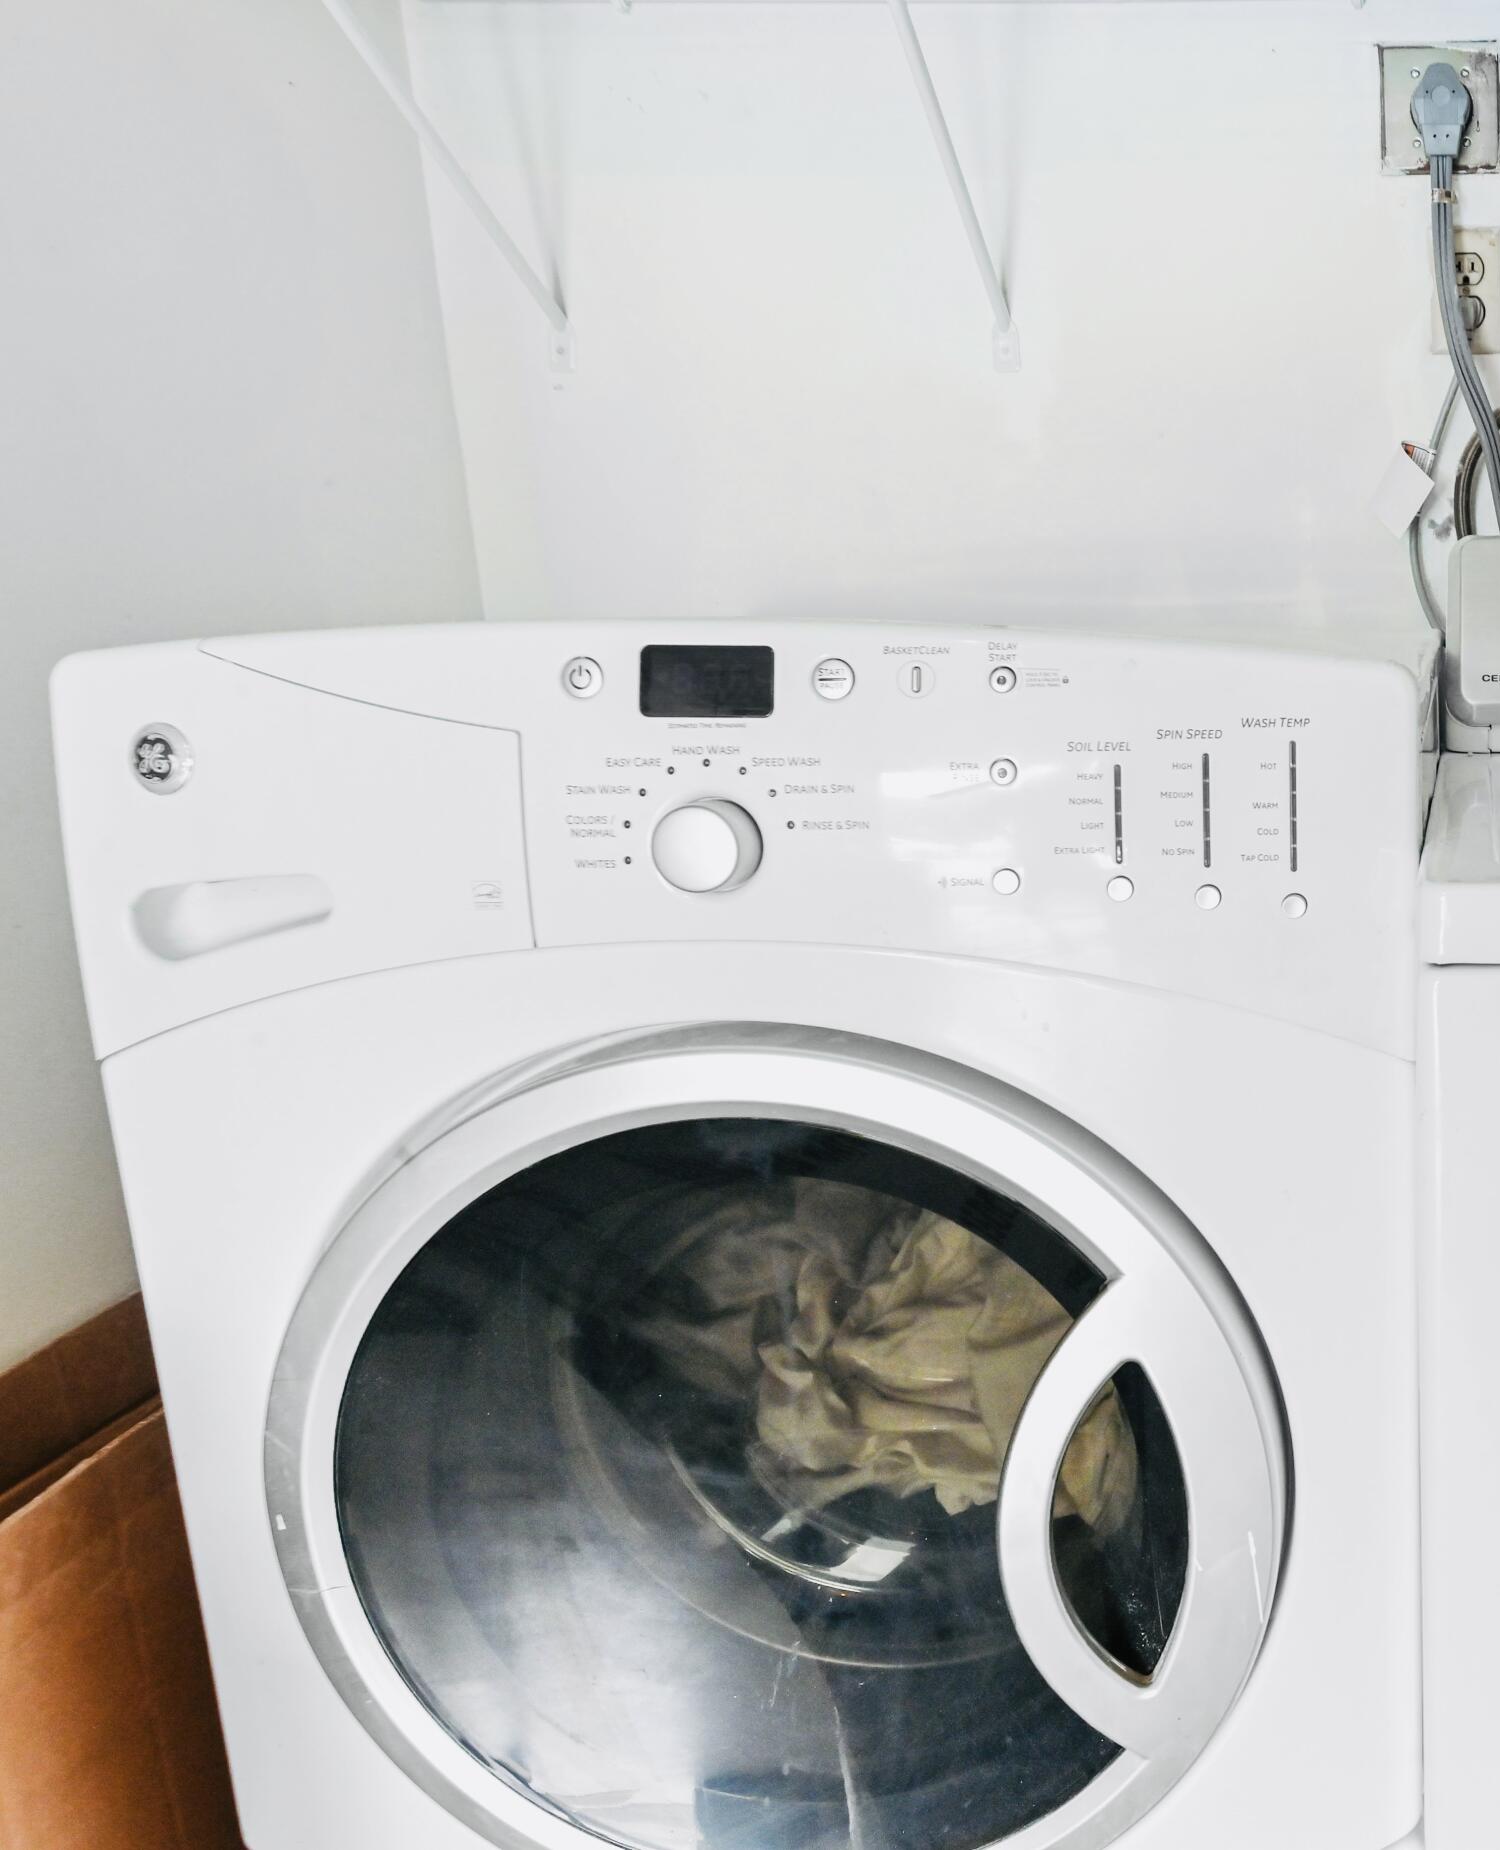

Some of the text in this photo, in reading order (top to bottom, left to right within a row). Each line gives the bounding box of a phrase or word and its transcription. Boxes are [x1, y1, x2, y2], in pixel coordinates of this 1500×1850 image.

[988, 642, 1018, 651] DELAY
[988, 653, 1016, 662] START
[1241, 717, 1311, 728] WASH TEMP
[1156, 729, 1223, 740] SPIN SPEED
[672, 745, 740, 755] HAND WASH
[1066, 741, 1131, 752] SOIL LEVEL
[606, 757, 662, 767] EASY CARE
[751, 757, 821, 767] SPEED WASH
[950, 762, 979, 771] EXTRA
[1172, 762, 1193, 770] HIGH
[1260, 762, 1277, 770] HOT
[1077, 773, 1104, 781] HEAVY
[566, 785, 631, 795] STAIN WASH
[784, 784, 855, 794] DRAIN & SPIN
[1160, 791, 1193, 799] MEDIUM
[1068, 797, 1104, 805] NORMAL
[1252, 802, 1279, 810] WARM
[566, 815, 607, 825] COLORS
[1174, 819, 1193, 827] LOW
[801, 820, 870, 830] RINSE & SPIN
[1080, 822, 1104, 830] LIGHT
[570, 829, 616, 839] NORMAL
[1257, 828, 1279, 836] COLD
[1054, 846, 1104, 854] EXTRA LIGHT
[1161, 848, 1175, 856] NO
[1241, 853, 1280, 862] TAP COLD
[575, 859, 616, 869] WHITES
[951, 877, 985, 887] SIGNAL
